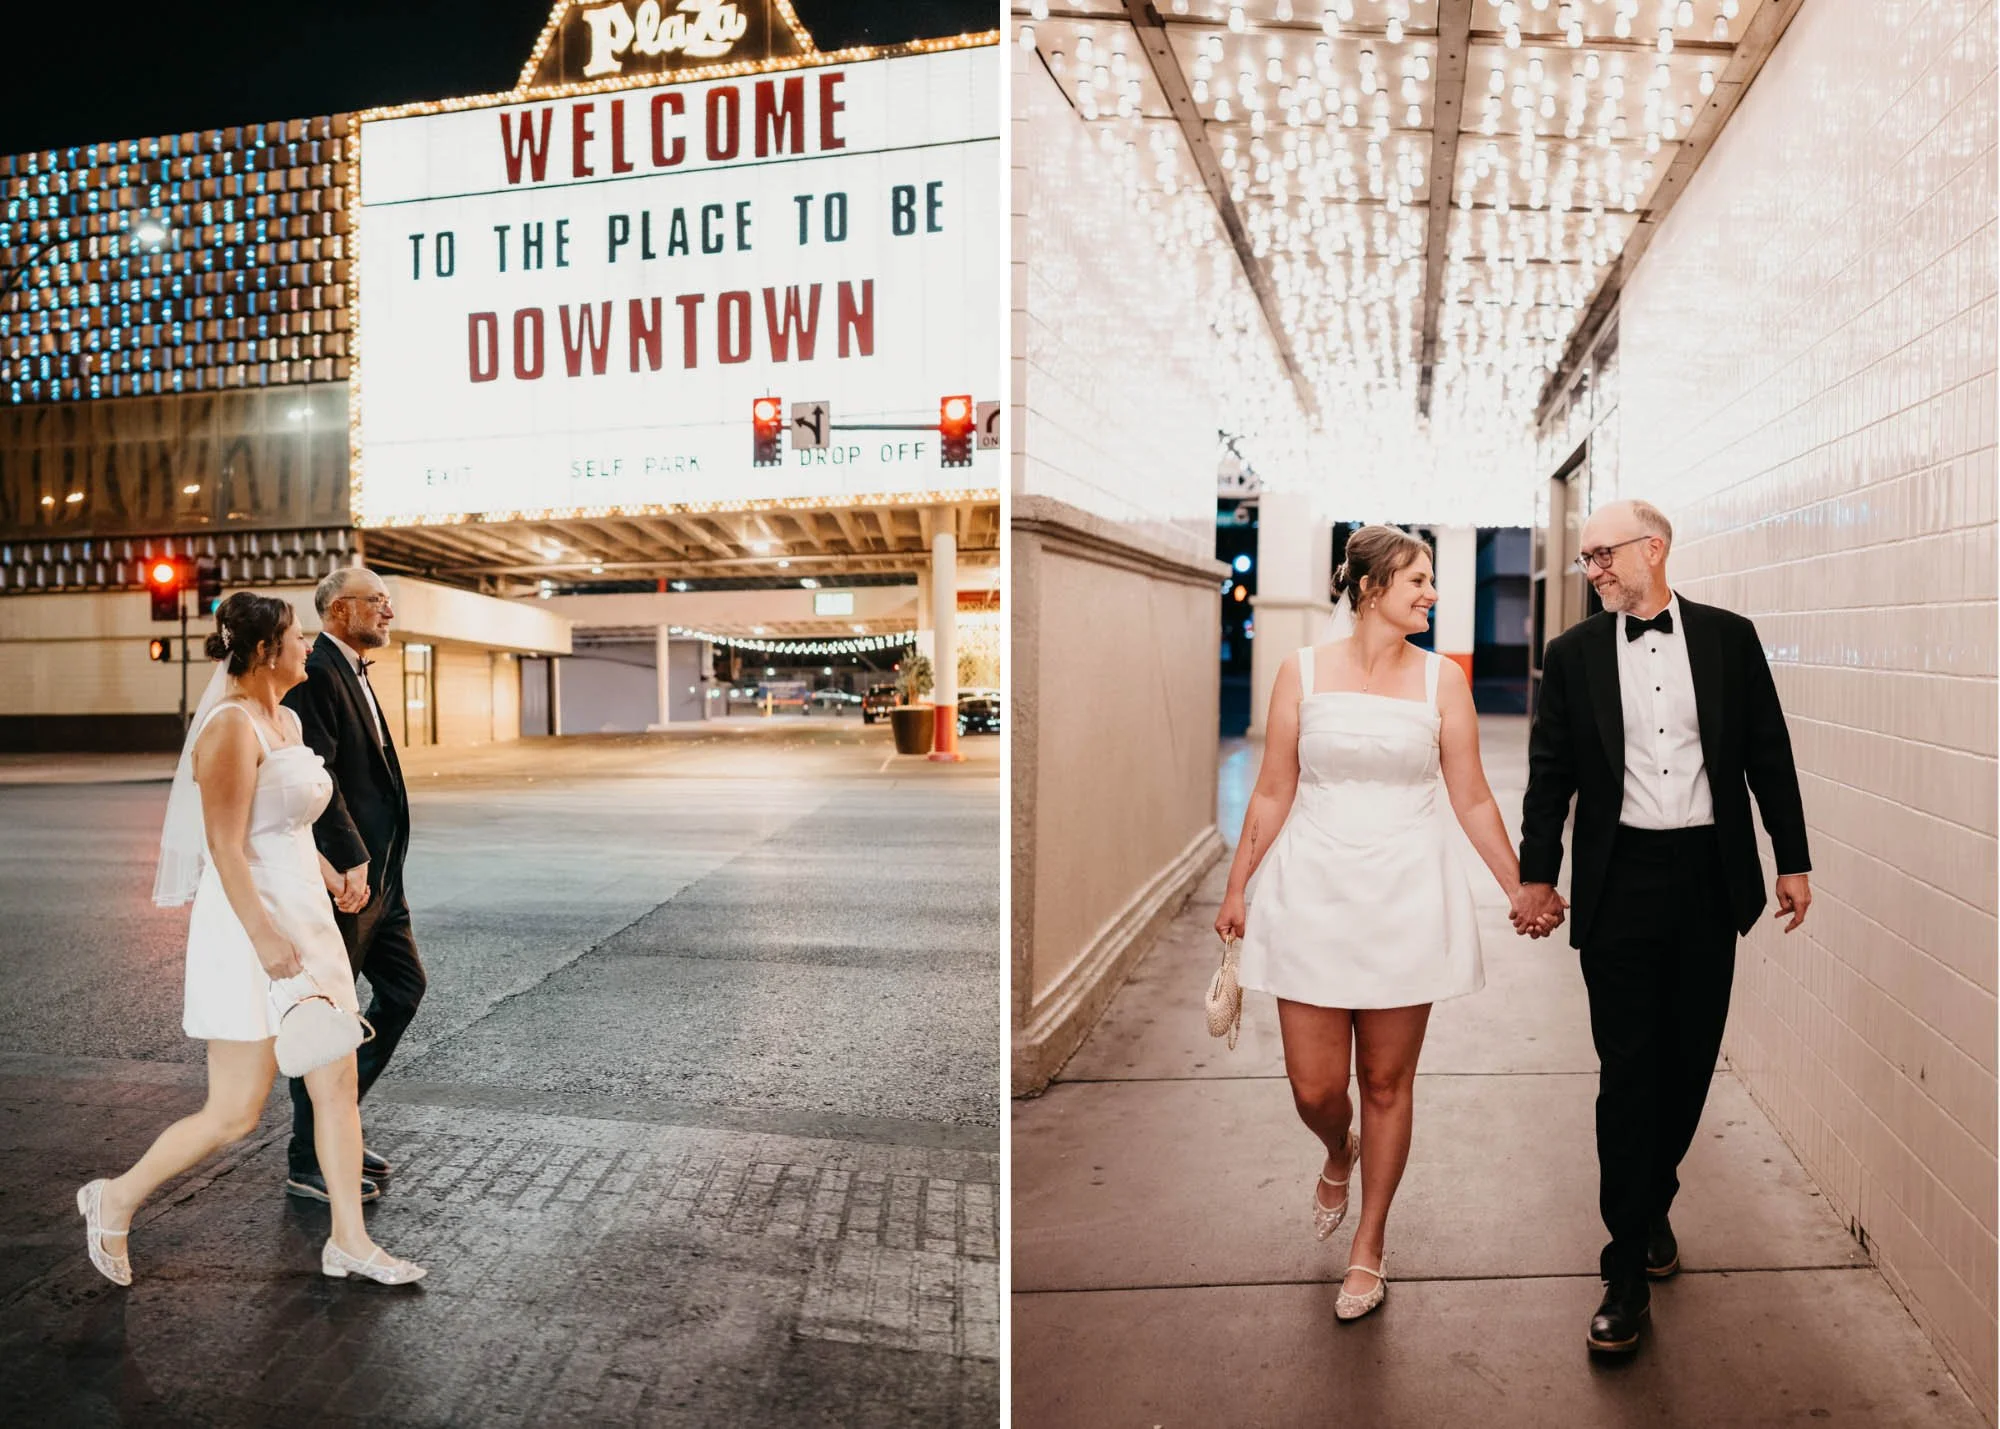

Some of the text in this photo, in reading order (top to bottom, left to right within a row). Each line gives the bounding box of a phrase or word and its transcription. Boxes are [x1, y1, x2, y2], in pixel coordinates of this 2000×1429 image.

[499, 72, 846, 185] WELCOME
[409, 181, 943, 280] TO THE PLACE TO BE
[468, 279, 875, 383] DOWNTOWN
[571, 456, 700, 479] SELF PARK
[800, 442, 926, 466] DROP OFF
